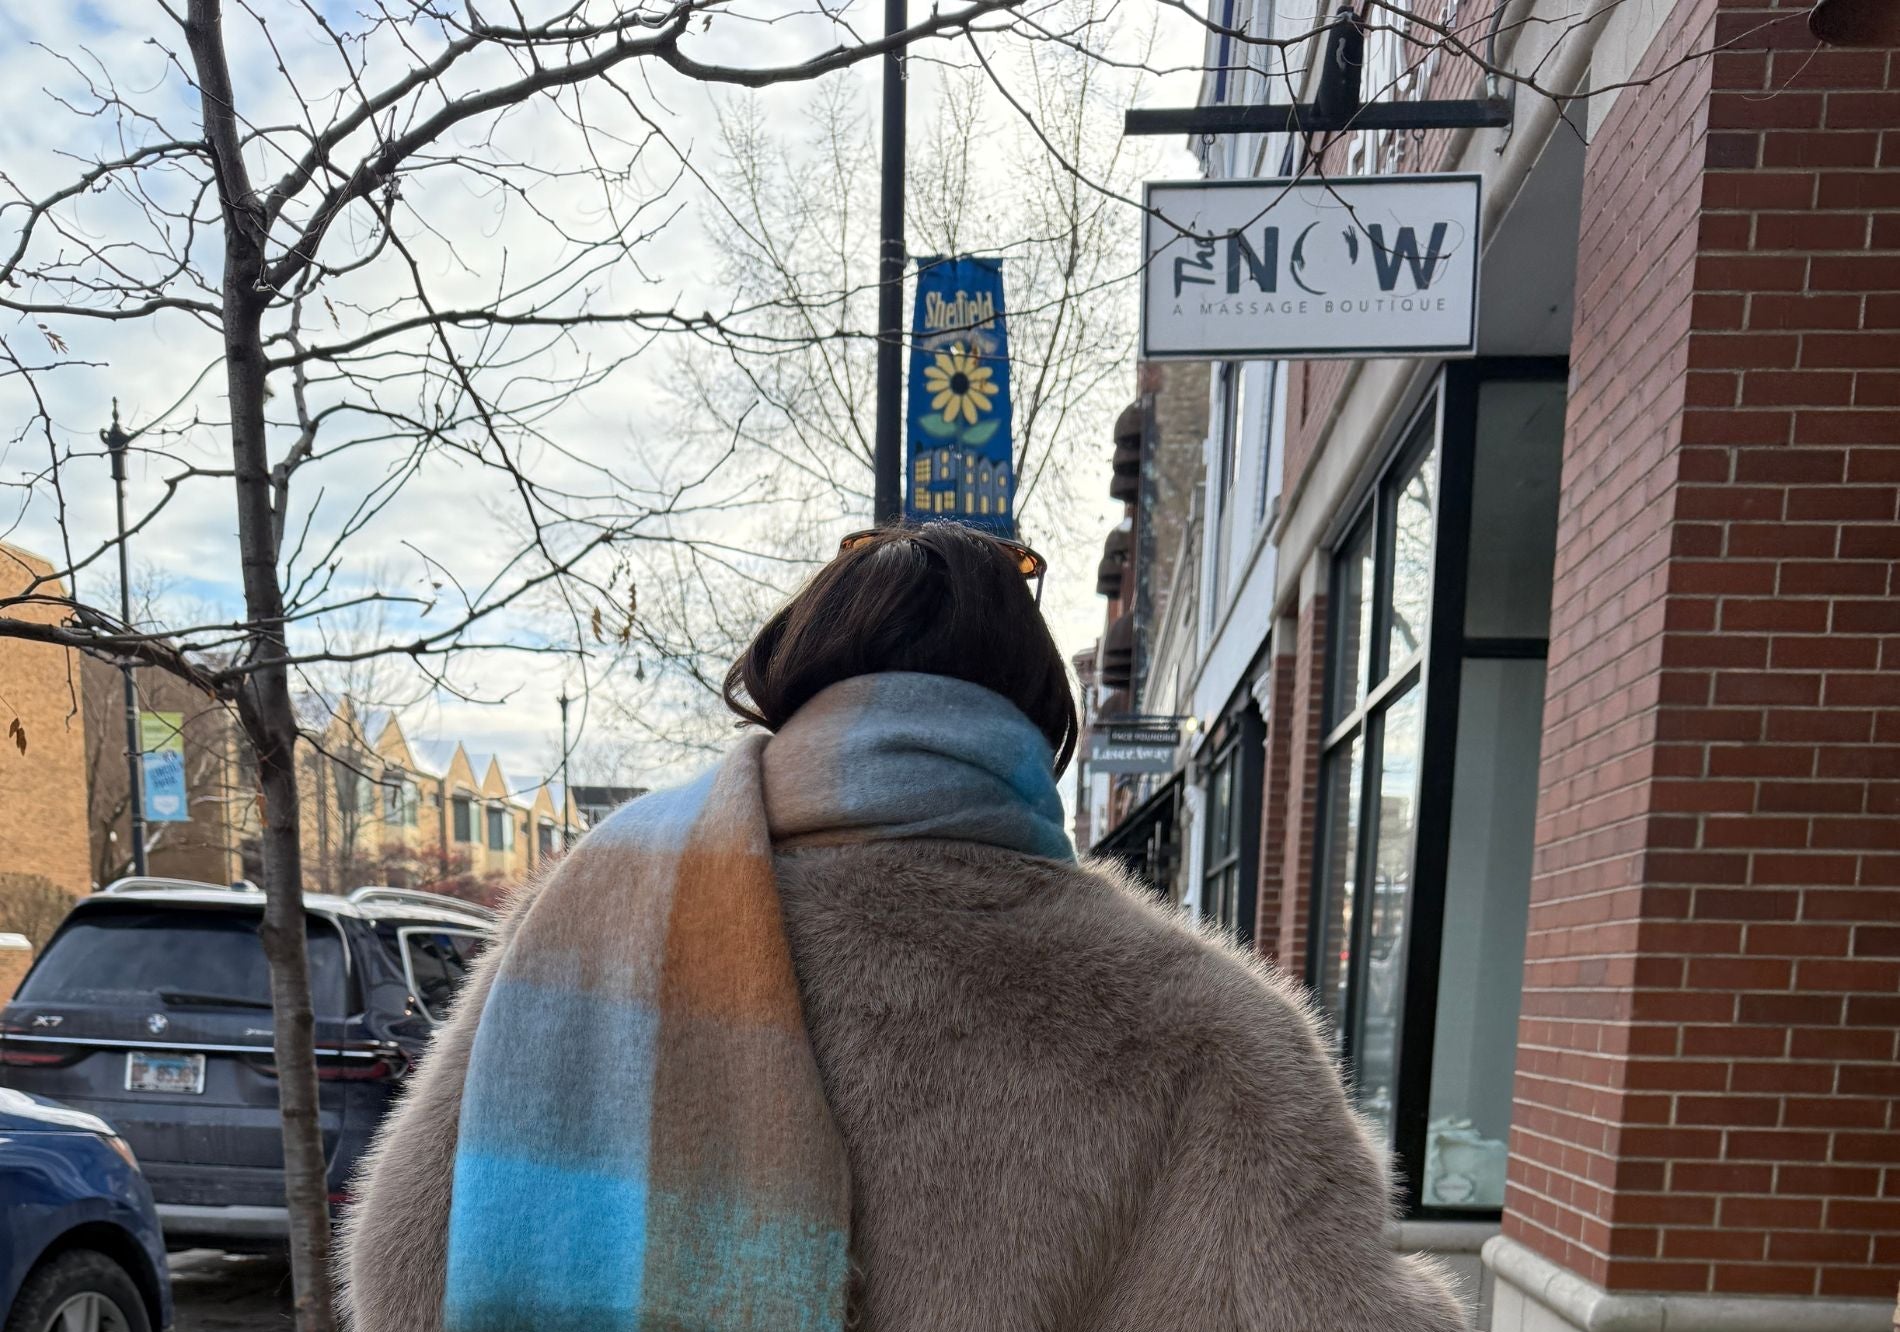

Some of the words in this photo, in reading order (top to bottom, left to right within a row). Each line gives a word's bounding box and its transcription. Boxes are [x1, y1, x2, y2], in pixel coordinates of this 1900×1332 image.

[1226, 221, 1448, 296] NOW
[925, 291, 995, 329] Sheffield
[1173, 303, 1184, 316] A
[1200, 300, 1308, 316] MASSAGE
[1325, 298, 1446, 314] BOUTIQUE
[32, 1015, 64, 1027] X7
